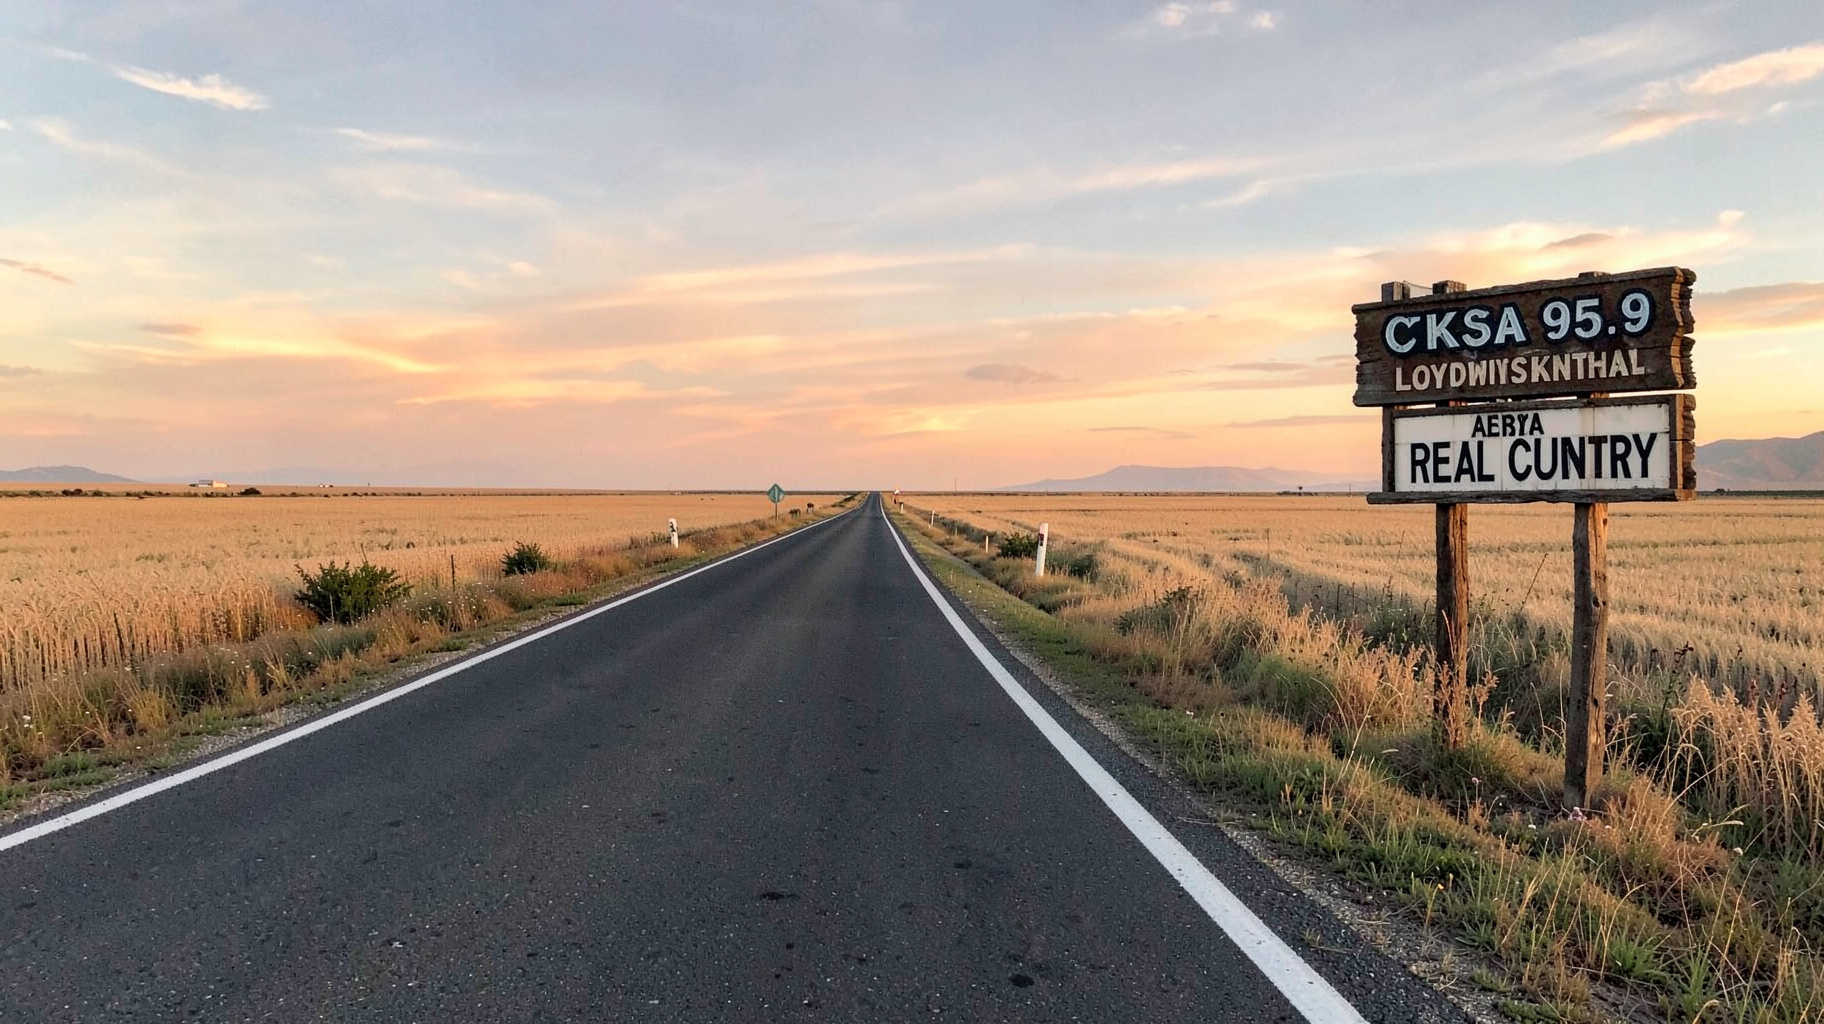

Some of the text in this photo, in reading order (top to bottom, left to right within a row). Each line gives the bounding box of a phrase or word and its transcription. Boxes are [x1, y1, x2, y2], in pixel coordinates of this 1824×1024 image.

[1385, 292, 1650, 353] CKSA 95.9
[1411, 433, 1657, 483] REAL CUNTRY
